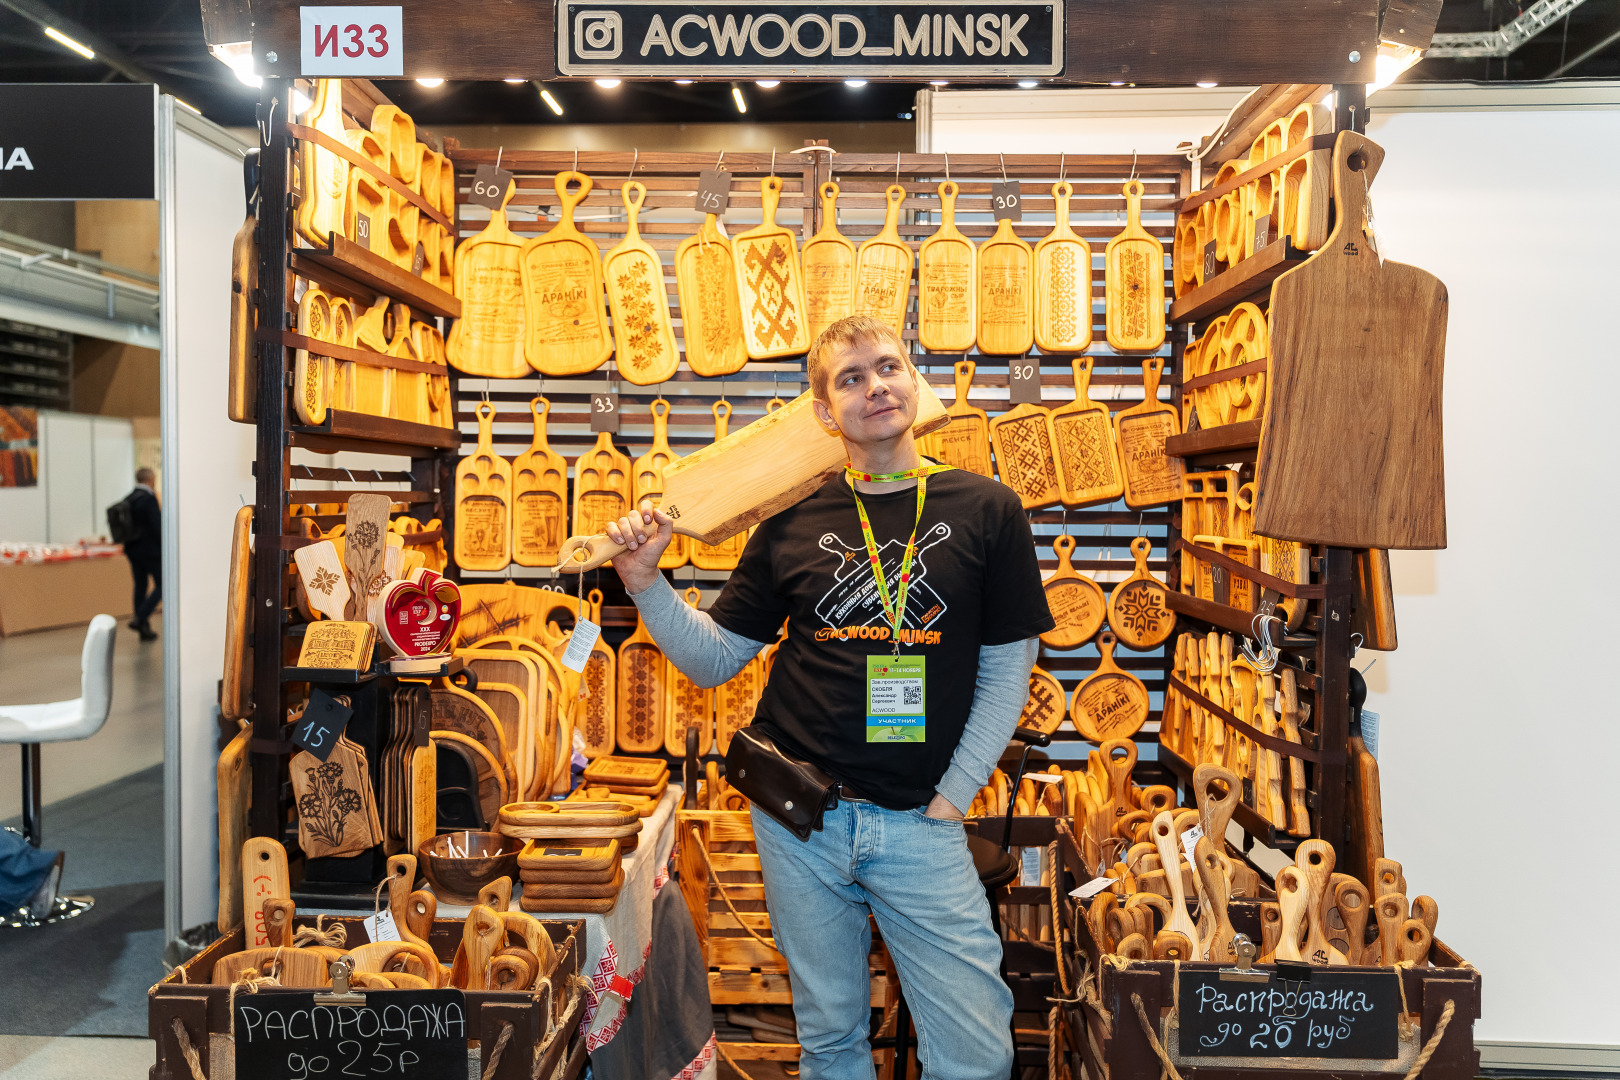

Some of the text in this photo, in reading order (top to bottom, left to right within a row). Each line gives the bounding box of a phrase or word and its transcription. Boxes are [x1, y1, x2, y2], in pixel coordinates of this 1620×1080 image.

[640, 13, 1029, 57] ACWOOD_MINSK
[474, 181, 500, 198] 60
[700, 190, 724, 209] 45
[996, 194, 1017, 209] 30
[358, 220, 369, 238] 50
[1205, 251, 1215, 275] 80
[988, 285, 1022, 295] ДРАНІКІ
[1013, 365, 1034, 380] 30
[594, 397, 614, 413] 33
[1212, 566, 1221, 584] 20
[303, 720, 331, 747] 15
[240, 1003, 466, 1043] РАСПРОДАЖА
[1306, 1016, 1355, 1049] руб
[287, 1049, 330, 1080] до
